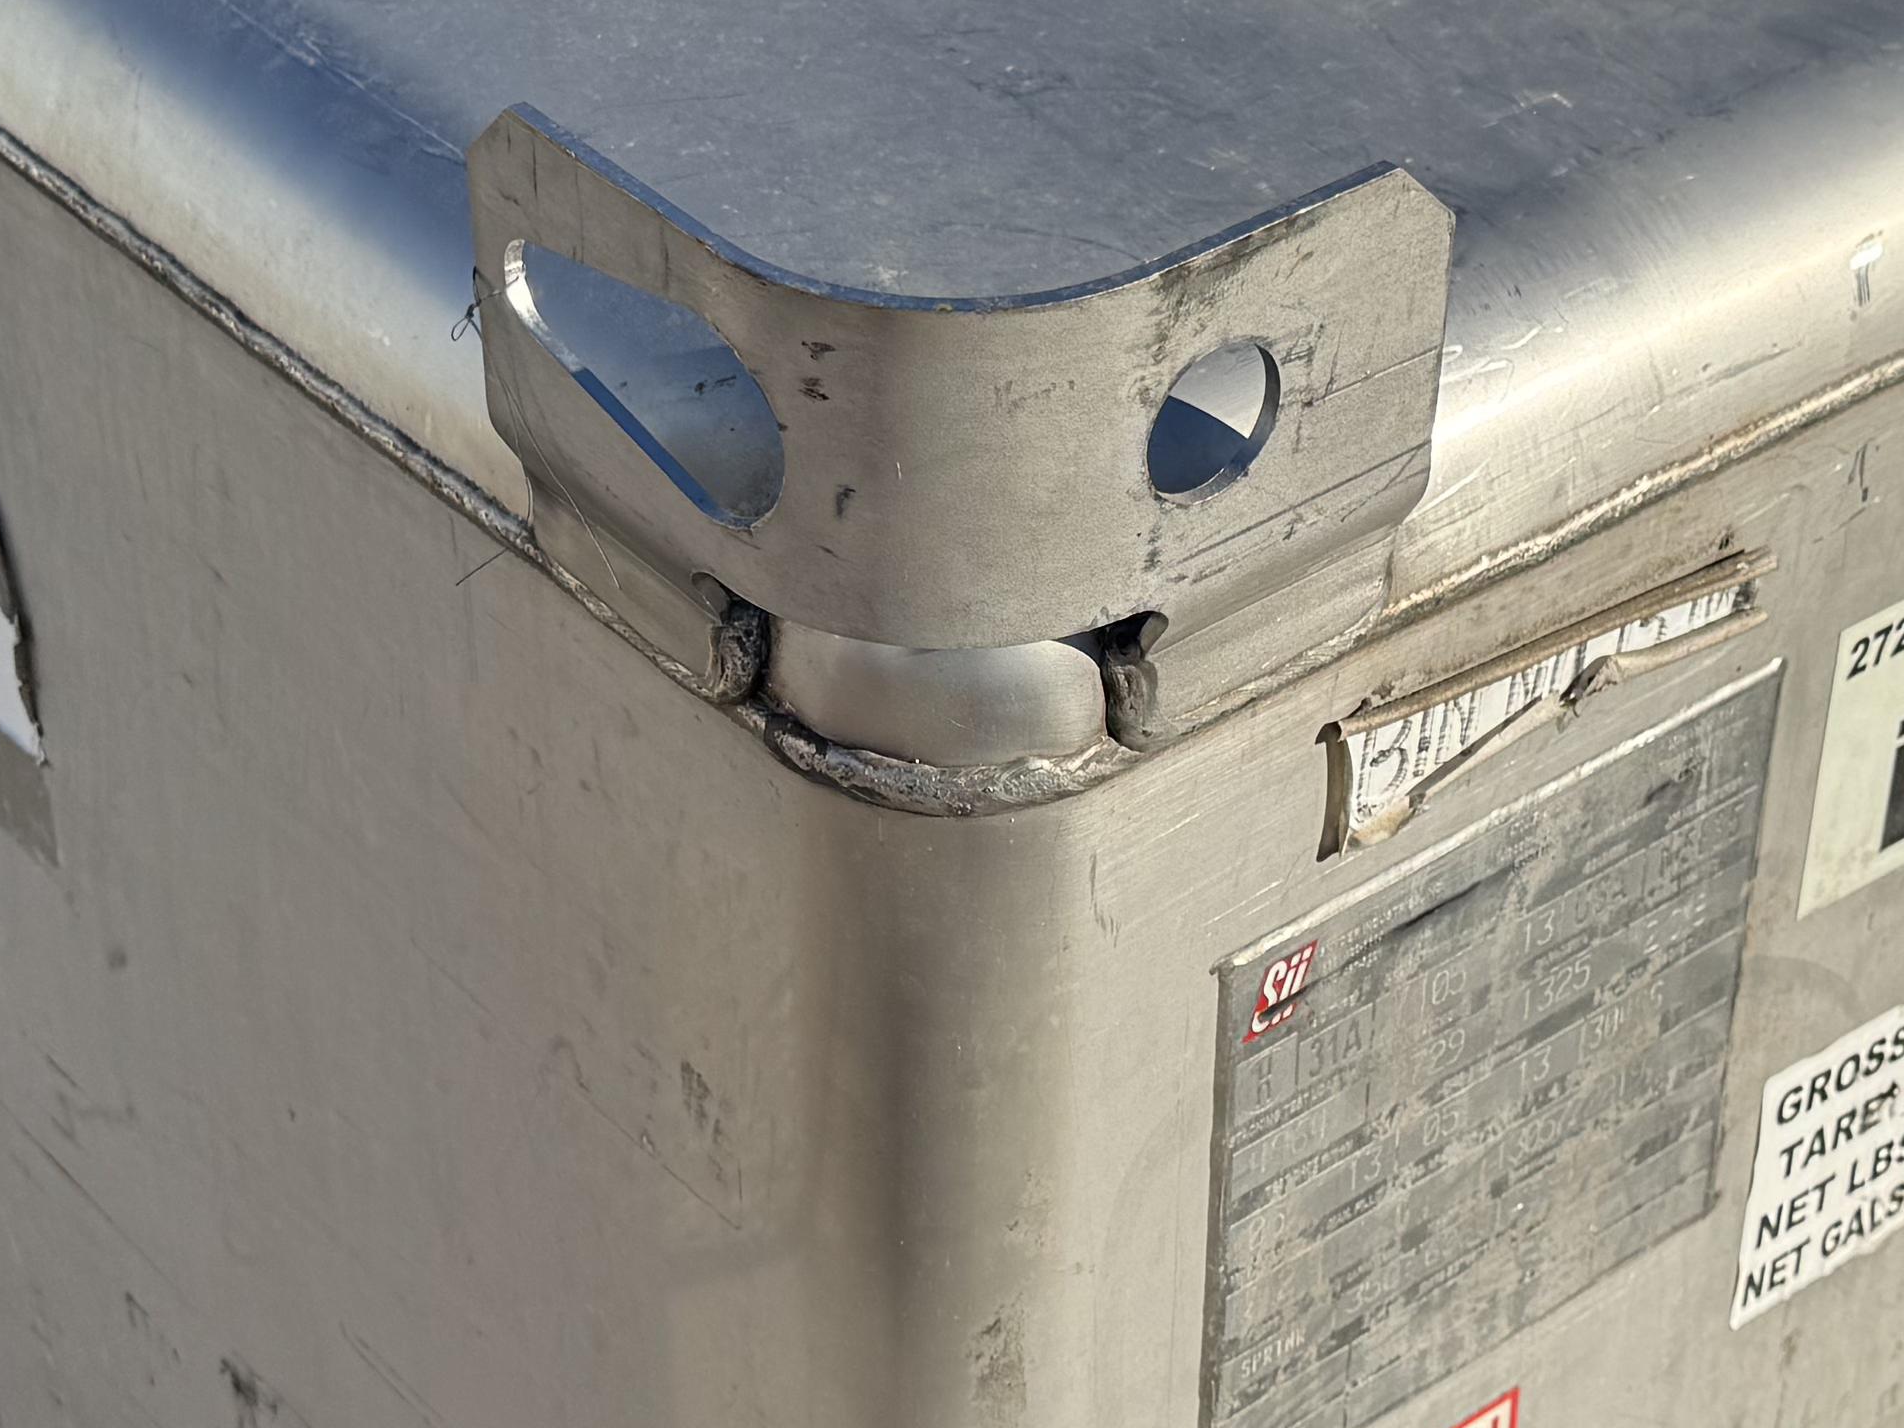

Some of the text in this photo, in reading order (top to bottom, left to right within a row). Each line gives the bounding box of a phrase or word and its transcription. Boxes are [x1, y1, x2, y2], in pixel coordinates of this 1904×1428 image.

[1523, 952, 1592, 1021] 1325
[1779, 1089, 1889, 1179] TARE
[1755, 1173, 1836, 1251] NET
[1741, 1236, 1812, 1308] NET
